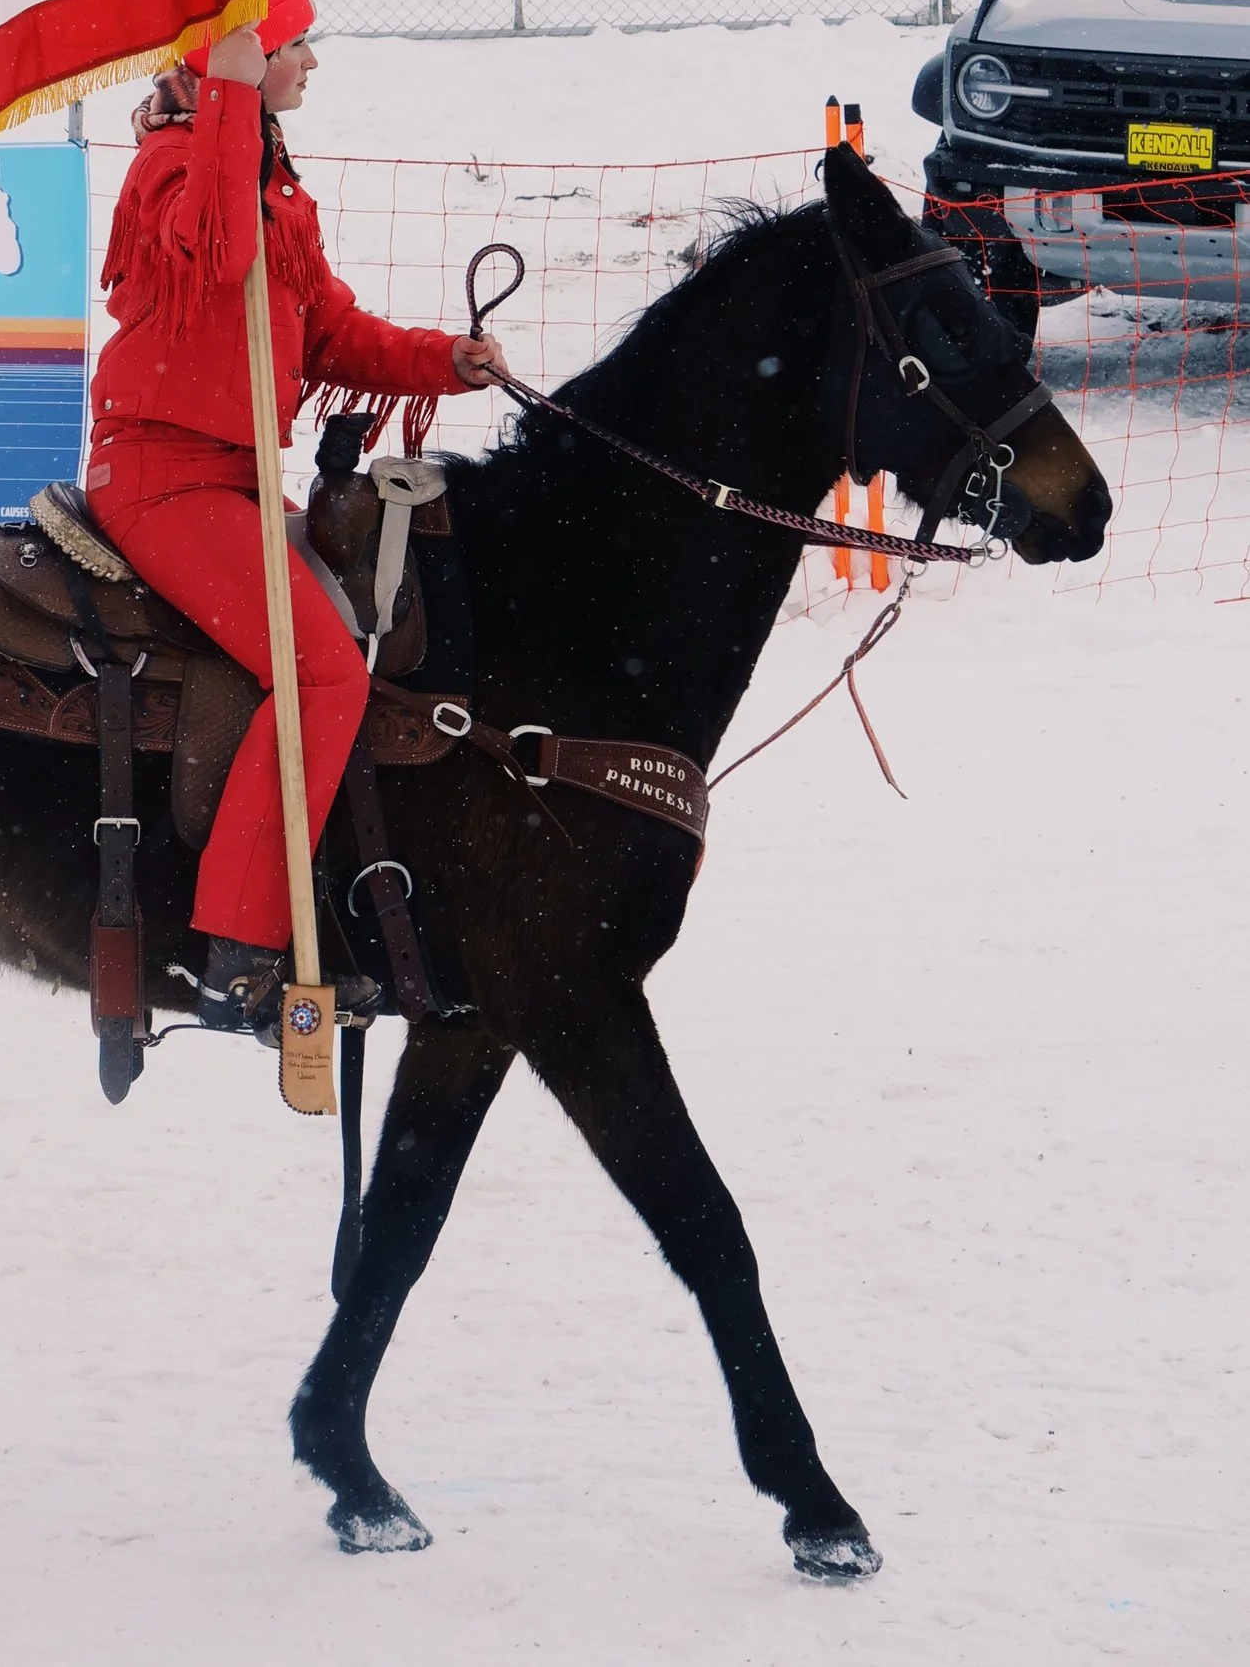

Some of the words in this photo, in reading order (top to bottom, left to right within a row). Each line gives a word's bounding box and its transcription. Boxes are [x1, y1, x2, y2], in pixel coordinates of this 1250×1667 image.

[1130, 131, 1211, 159] KENDALL
[1145, 161, 1192, 173] KENDALL
[630, 757, 686, 781] RODEO
[606, 768, 693, 816] PRINCESS
